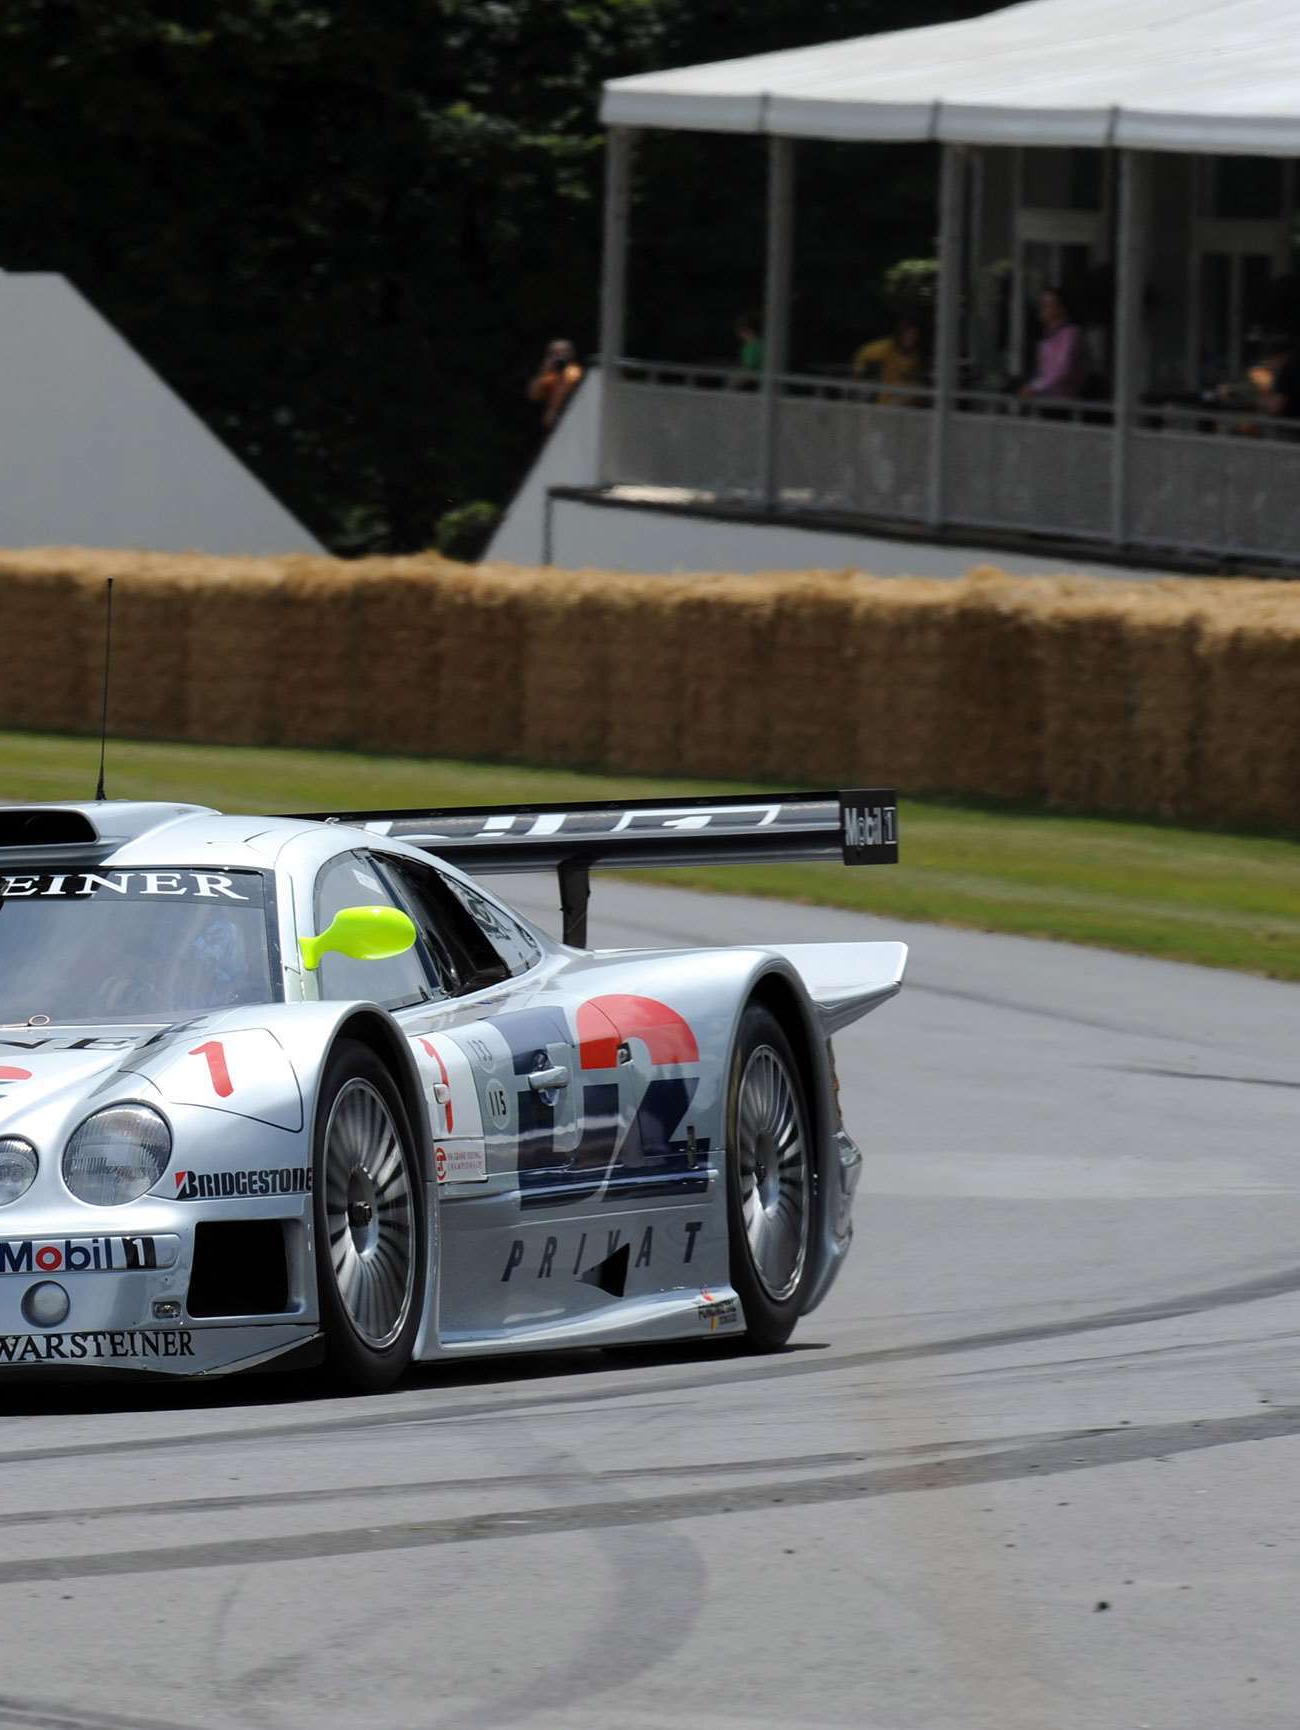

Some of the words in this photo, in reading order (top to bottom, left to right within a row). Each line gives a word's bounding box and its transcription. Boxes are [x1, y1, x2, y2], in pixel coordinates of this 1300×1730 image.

[188, 1041, 234, 1098] 1
[488, 1090, 507, 1117] 115
[174, 1167, 313, 1199] BRIDGESTONE
